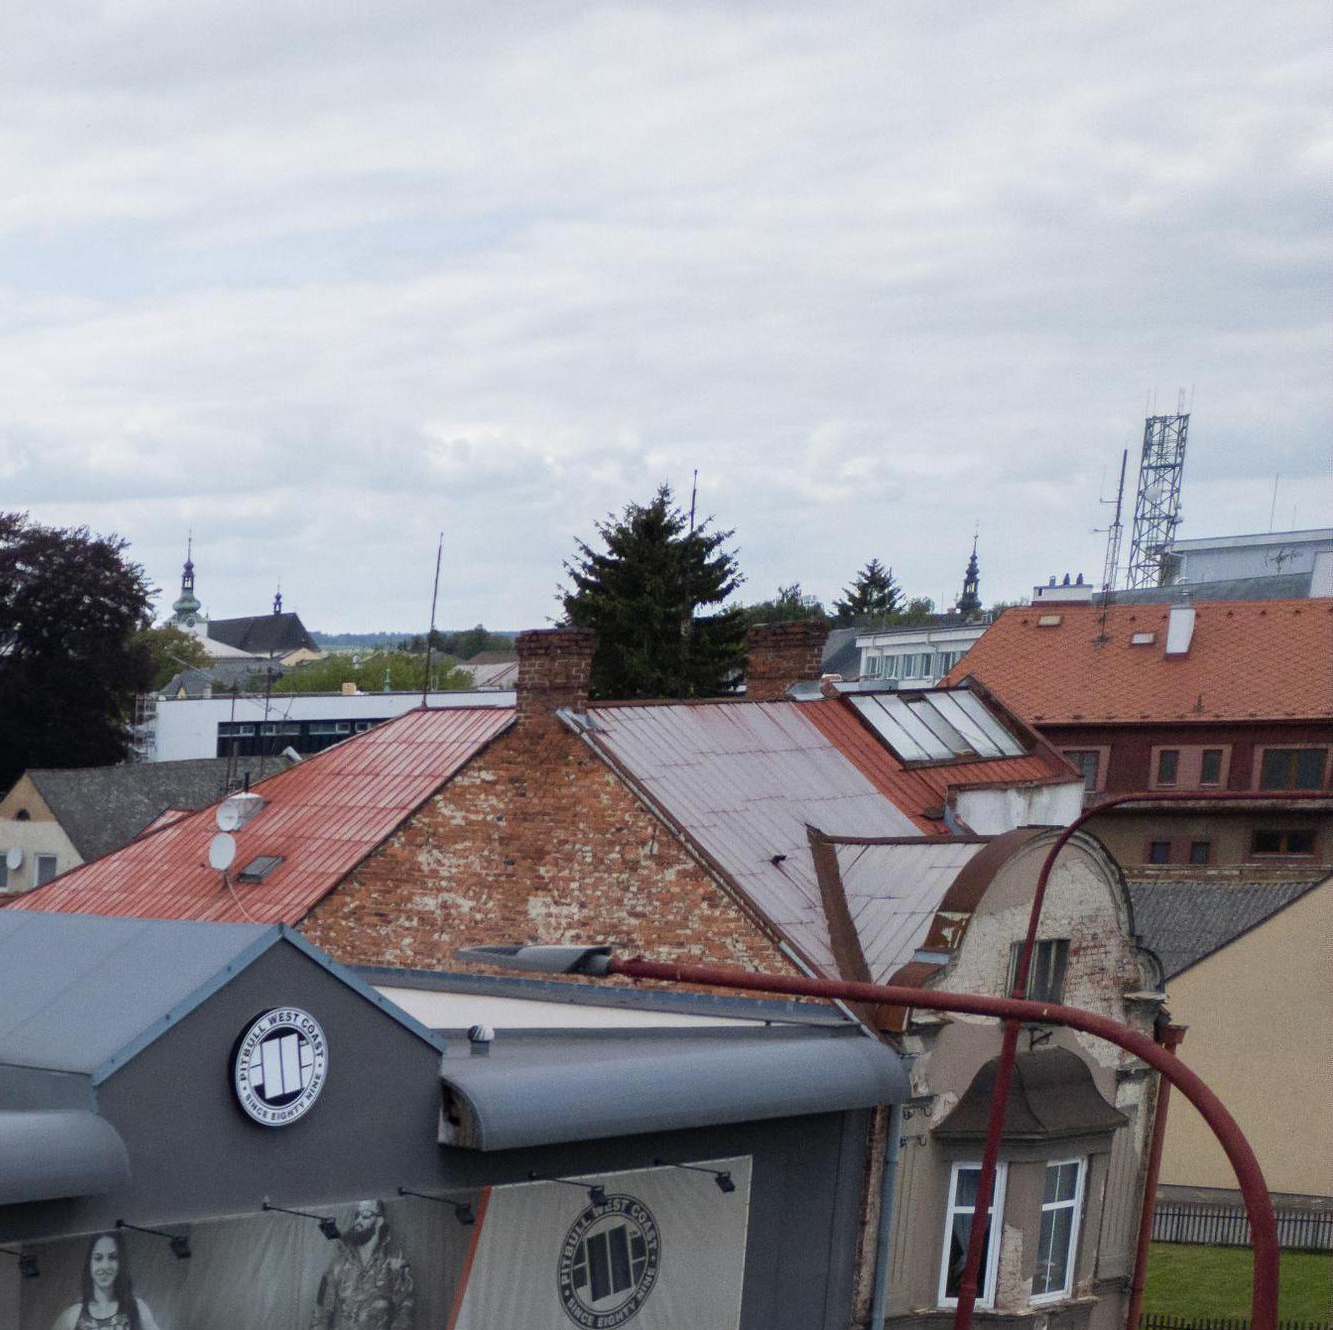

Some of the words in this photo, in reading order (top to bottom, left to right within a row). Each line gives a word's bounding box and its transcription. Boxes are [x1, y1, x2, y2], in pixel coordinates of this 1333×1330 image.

[239, 1025, 266, 1082] PITBULL
[267, 1011, 299, 1026] WEST
[301, 1018, 324, 1058] COAST
[244, 1093, 268, 1119] SINCE
[270, 1102, 305, 1121] EIGHTY
[560, 1217, 592, 1286] PITBULL
[630, 1203, 657, 1249] COAST
